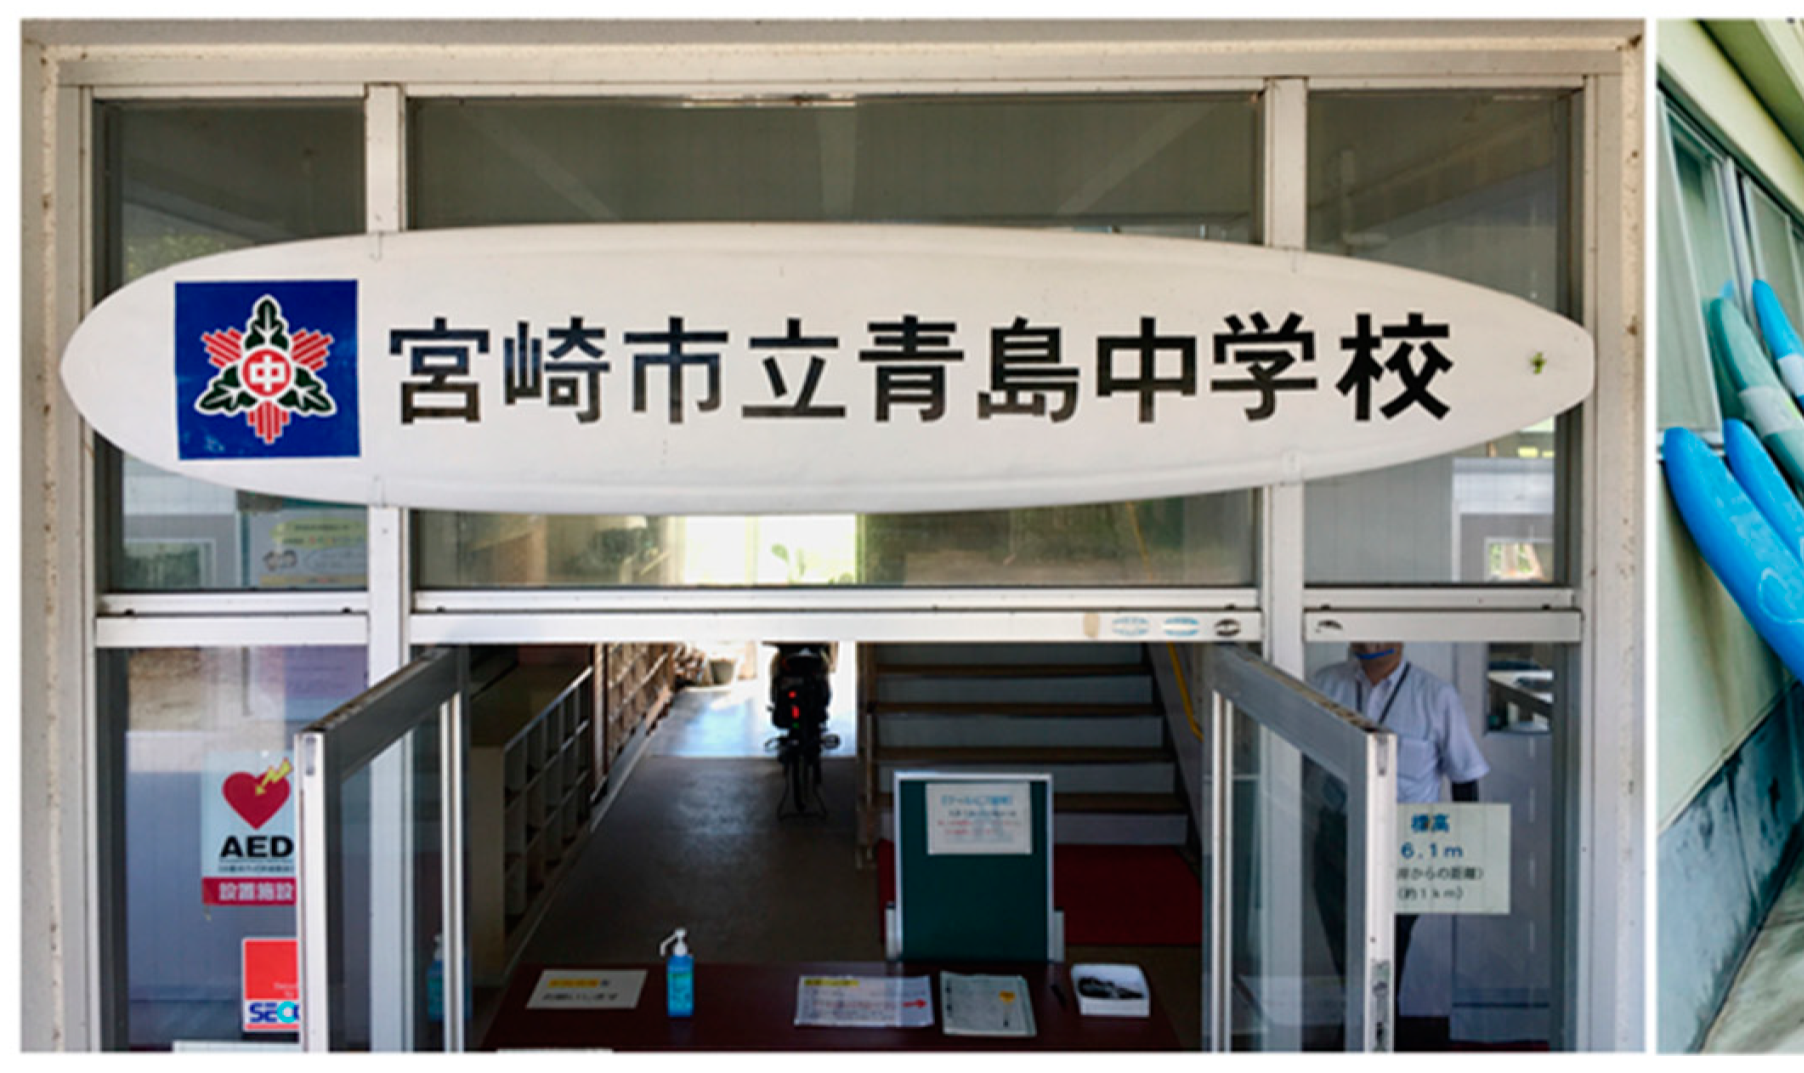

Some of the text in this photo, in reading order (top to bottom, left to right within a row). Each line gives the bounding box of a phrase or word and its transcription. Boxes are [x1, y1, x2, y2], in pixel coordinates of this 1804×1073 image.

[250, 355, 285, 391] 中
[388, 312, 1454, 424] 宮崎市立青島中学校
[219, 834, 295, 858] AED
